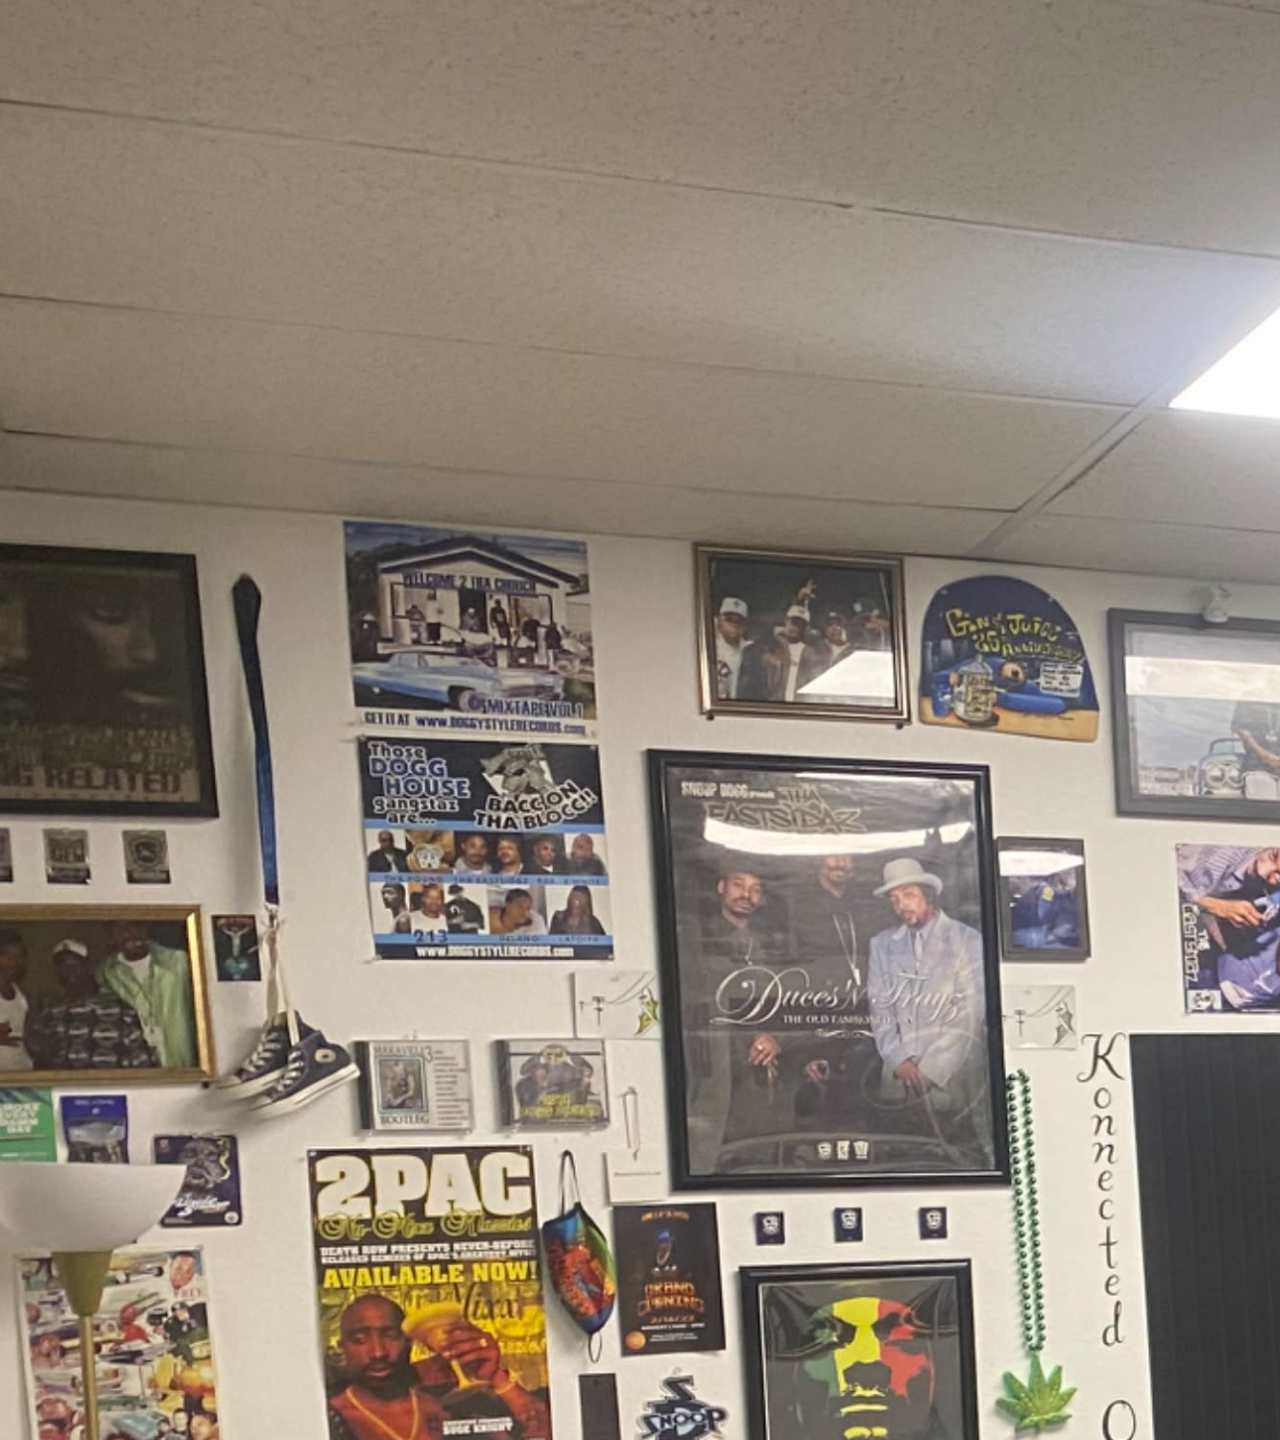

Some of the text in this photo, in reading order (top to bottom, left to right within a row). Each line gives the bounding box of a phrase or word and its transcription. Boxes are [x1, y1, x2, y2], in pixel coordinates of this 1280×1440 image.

[364, 711, 383, 723] GET
[367, 741, 425, 759] Those
[371, 758, 448, 776] DOGG
[385, 778, 470, 797] HOUSE
[545, 780, 579, 806] ON
[475, 811, 520, 829] THA
[413, 929, 449, 943] 213
[314, 1151, 533, 1220] 2PAC
[1076, 1032, 1129, 1347] Konnected
[323, 1260, 537, 1288] AVAILABLE NOW!
